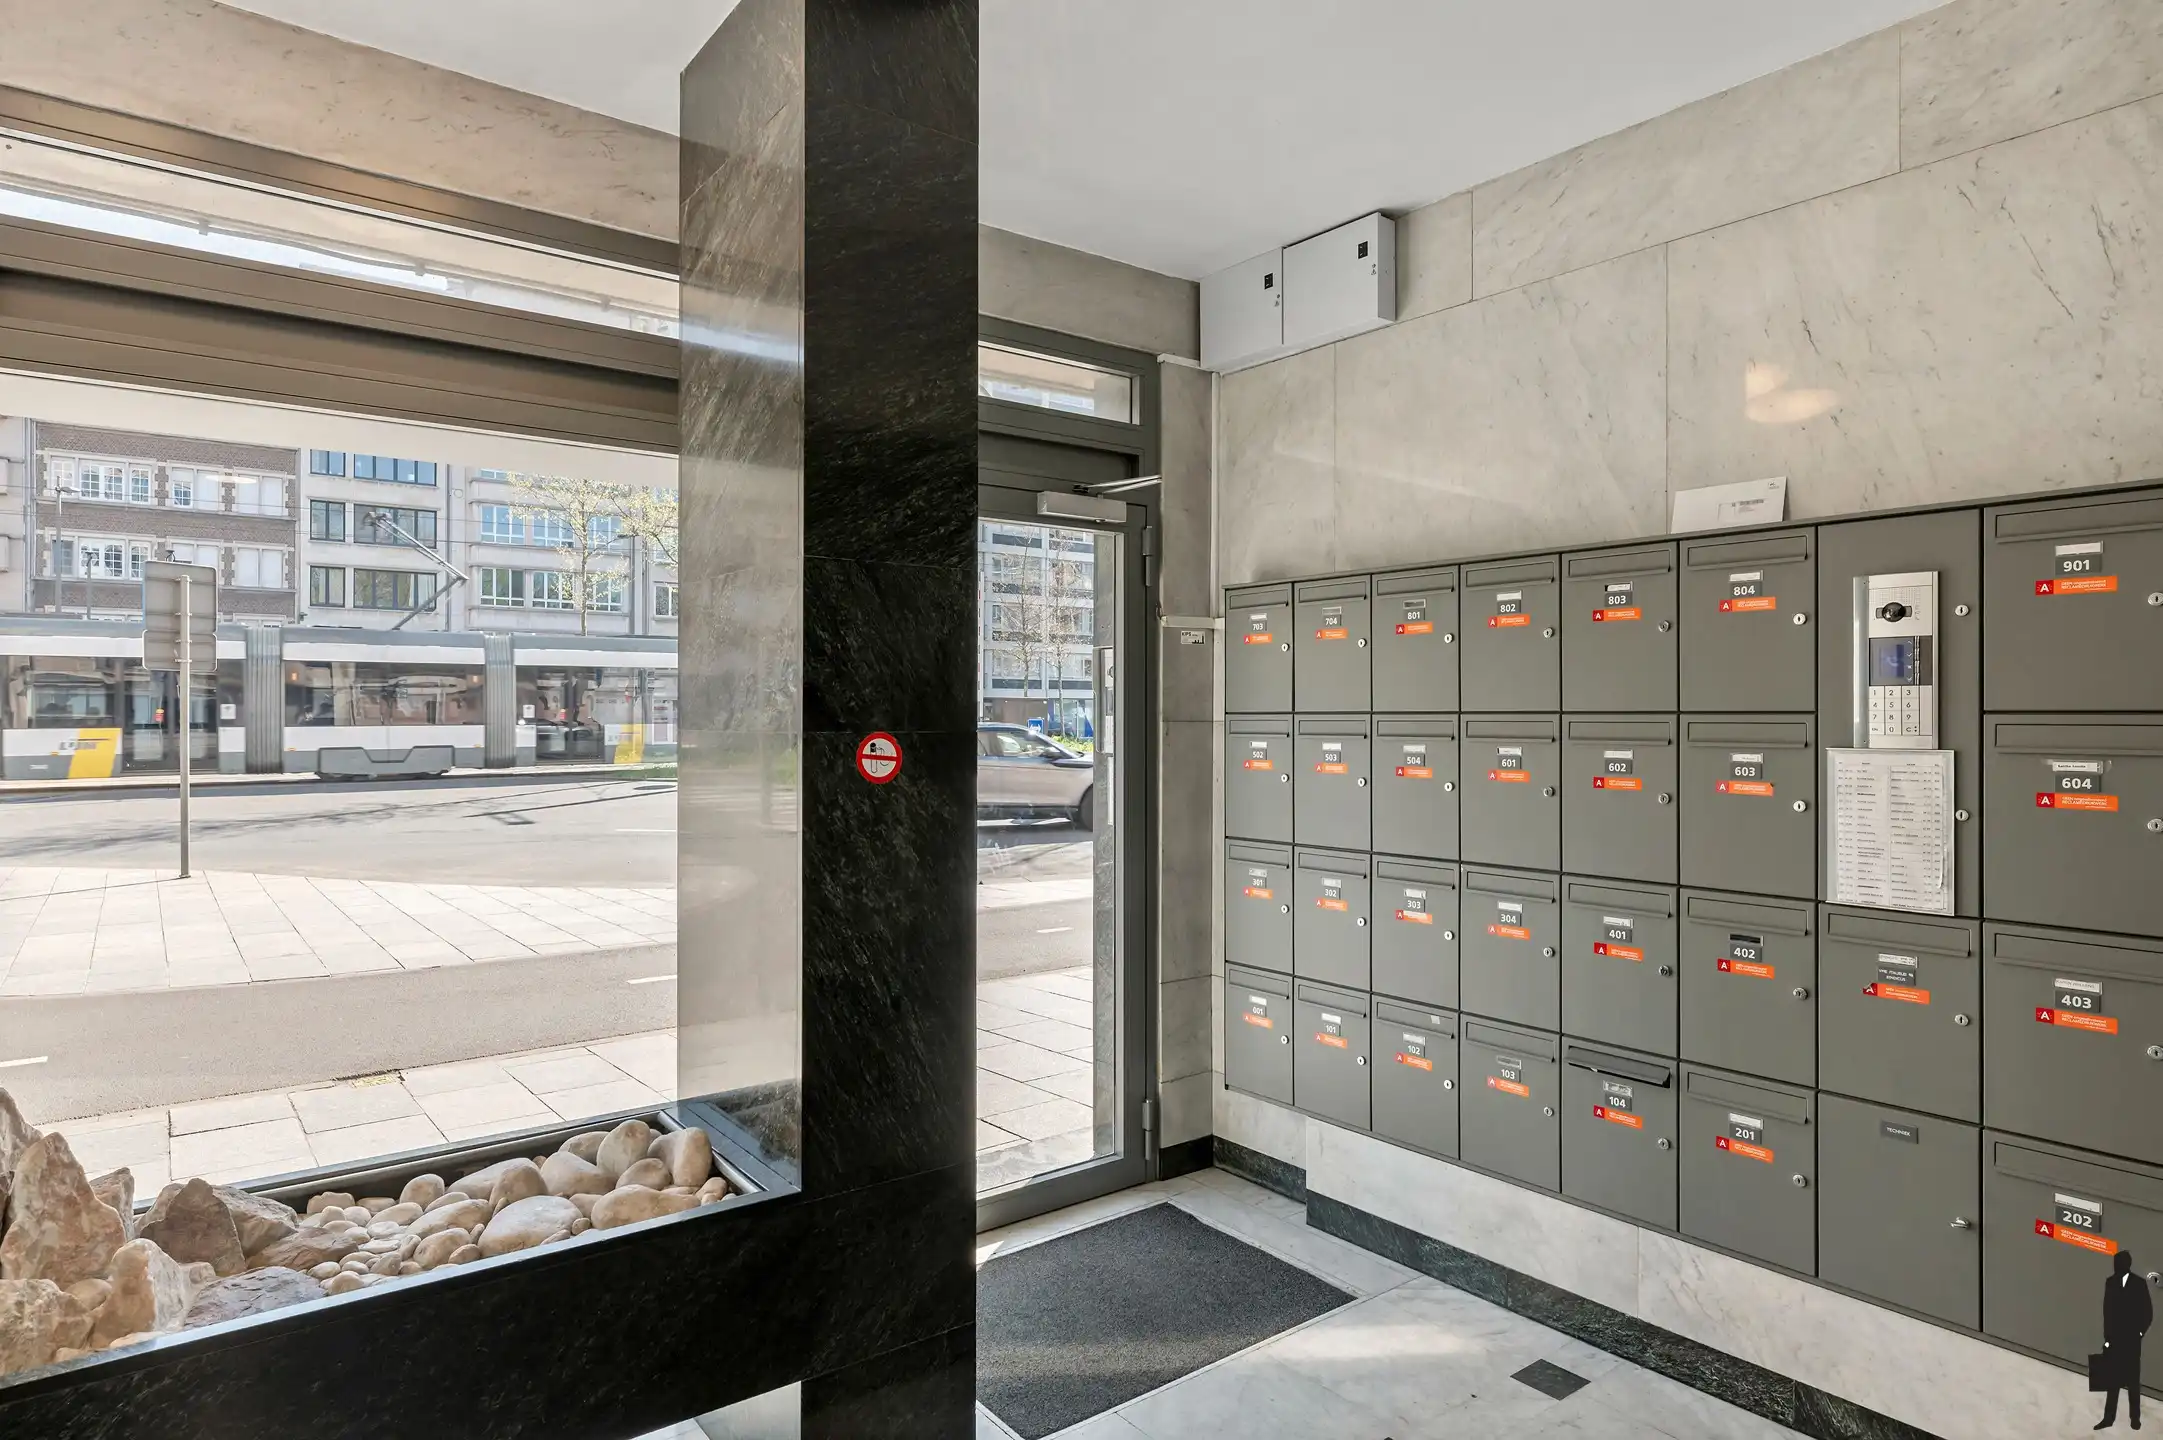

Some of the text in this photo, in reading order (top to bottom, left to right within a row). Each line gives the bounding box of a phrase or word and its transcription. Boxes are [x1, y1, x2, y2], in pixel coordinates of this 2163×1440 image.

[2064, 560, 2090, 572] 901
[1734, 586, 1756, 596] 804
[2040, 584, 2049, 592] A
[1608, 596, 1626, 604] 803
[1500, 604, 1516, 612] 802
[1408, 612, 1420, 620] 801
[1252, 622, 1264, 630] 703
[1326, 618, 1338, 626] 704
[1252, 750, 1264, 758] 502
[1326, 754, 1338, 762] 503
[1406, 756, 1420, 764] 504
[1502, 758, 1516, 768] 601
[1608, 762, 1626, 772] 602
[1734, 766, 1756, 776] 603
[2062, 778, 2092, 790] 604
[2041, 796, 2050, 804] A
[1252, 878, 1262, 886] 301
[1324, 888, 1336, 898] 302
[1408, 900, 1420, 908] 303
[1500, 914, 1516, 924] 304
[1608, 930, 1626, 940] 401
[1734, 948, 1756, 958] 402
[2062, 994, 2092, 1008] 403
[1252, 1006, 1264, 1016] 001
[2040, 1011, 2050, 1020] A
[1326, 1024, 1336, 1034] 101
[1408, 1044, 1420, 1056] 102
[1500, 1068, 1516, 1080] 103
[1610, 1096, 1626, 1108] 104
[1736, 1128, 1754, 1140] 201
[1886, 1126, 1910, 1136] TECHNIEK
[2062, 1210, 2092, 1228] 202
[2040, 1224, 2049, 1234] A
